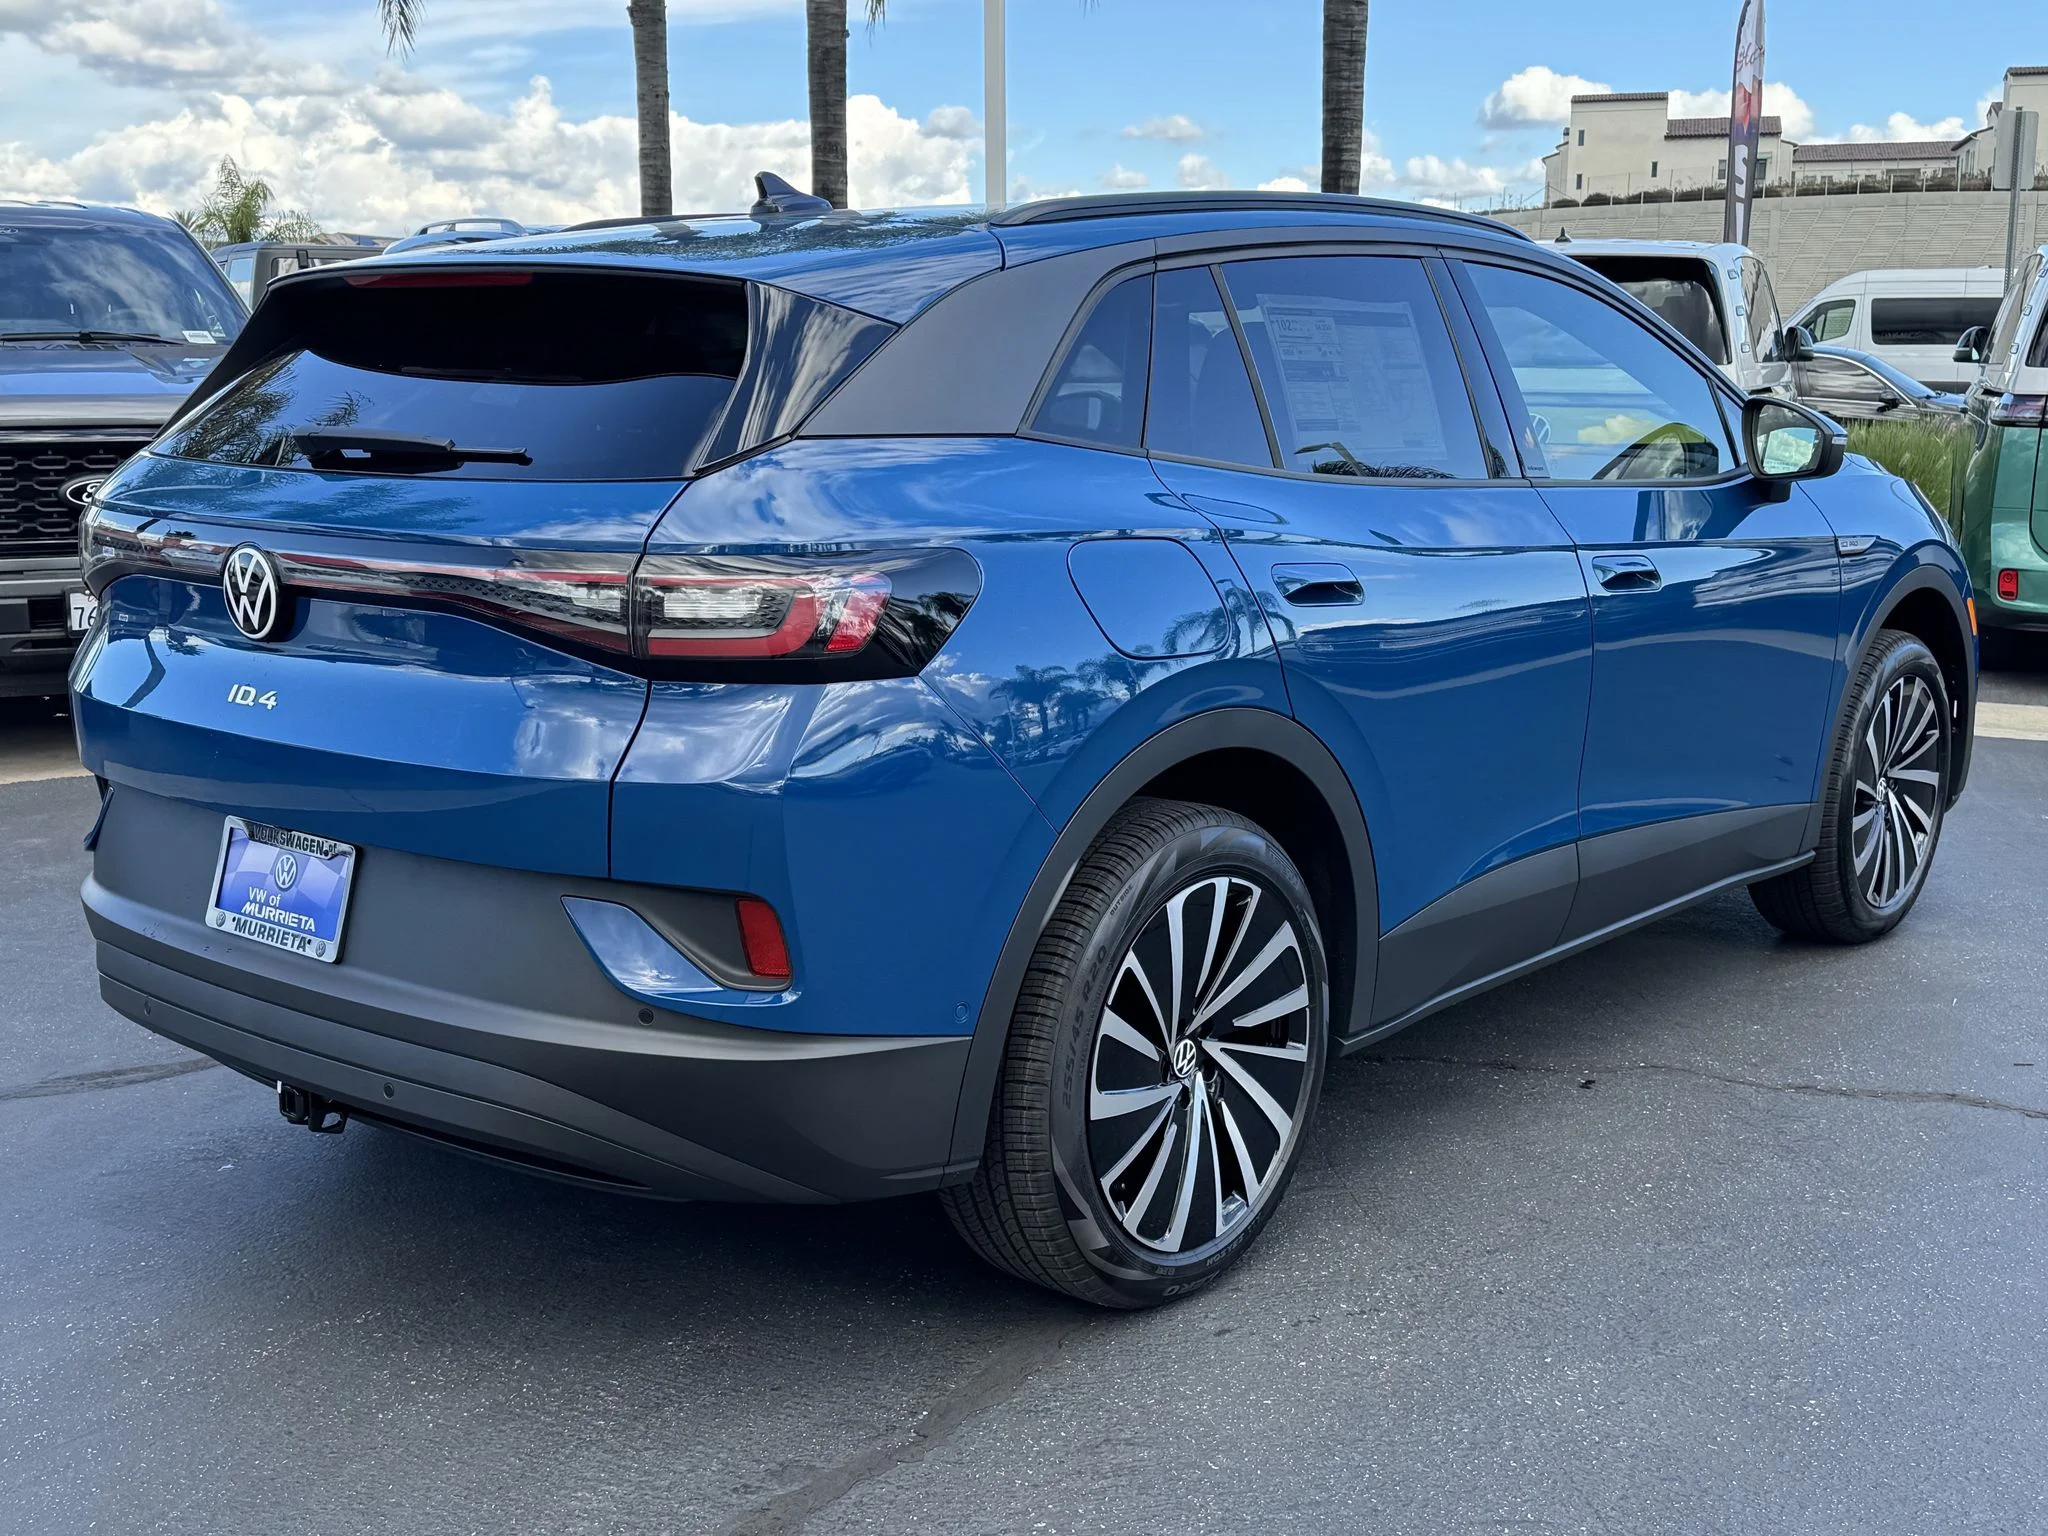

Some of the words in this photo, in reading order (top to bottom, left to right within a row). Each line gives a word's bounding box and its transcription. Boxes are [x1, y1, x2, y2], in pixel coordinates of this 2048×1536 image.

[253, 825, 326, 856] VOLKSWAGEN
[249, 886, 267, 903] VW
[269, 893, 281, 907] of
[1109, 884, 1134, 917] OUTSIDE
[241, 901, 316, 933] MURRIETA
[234, 916, 308, 952] MURRIETA
[1062, 1006, 1085, 1107] 255/45
[1083, 945, 1107, 1001] R20
